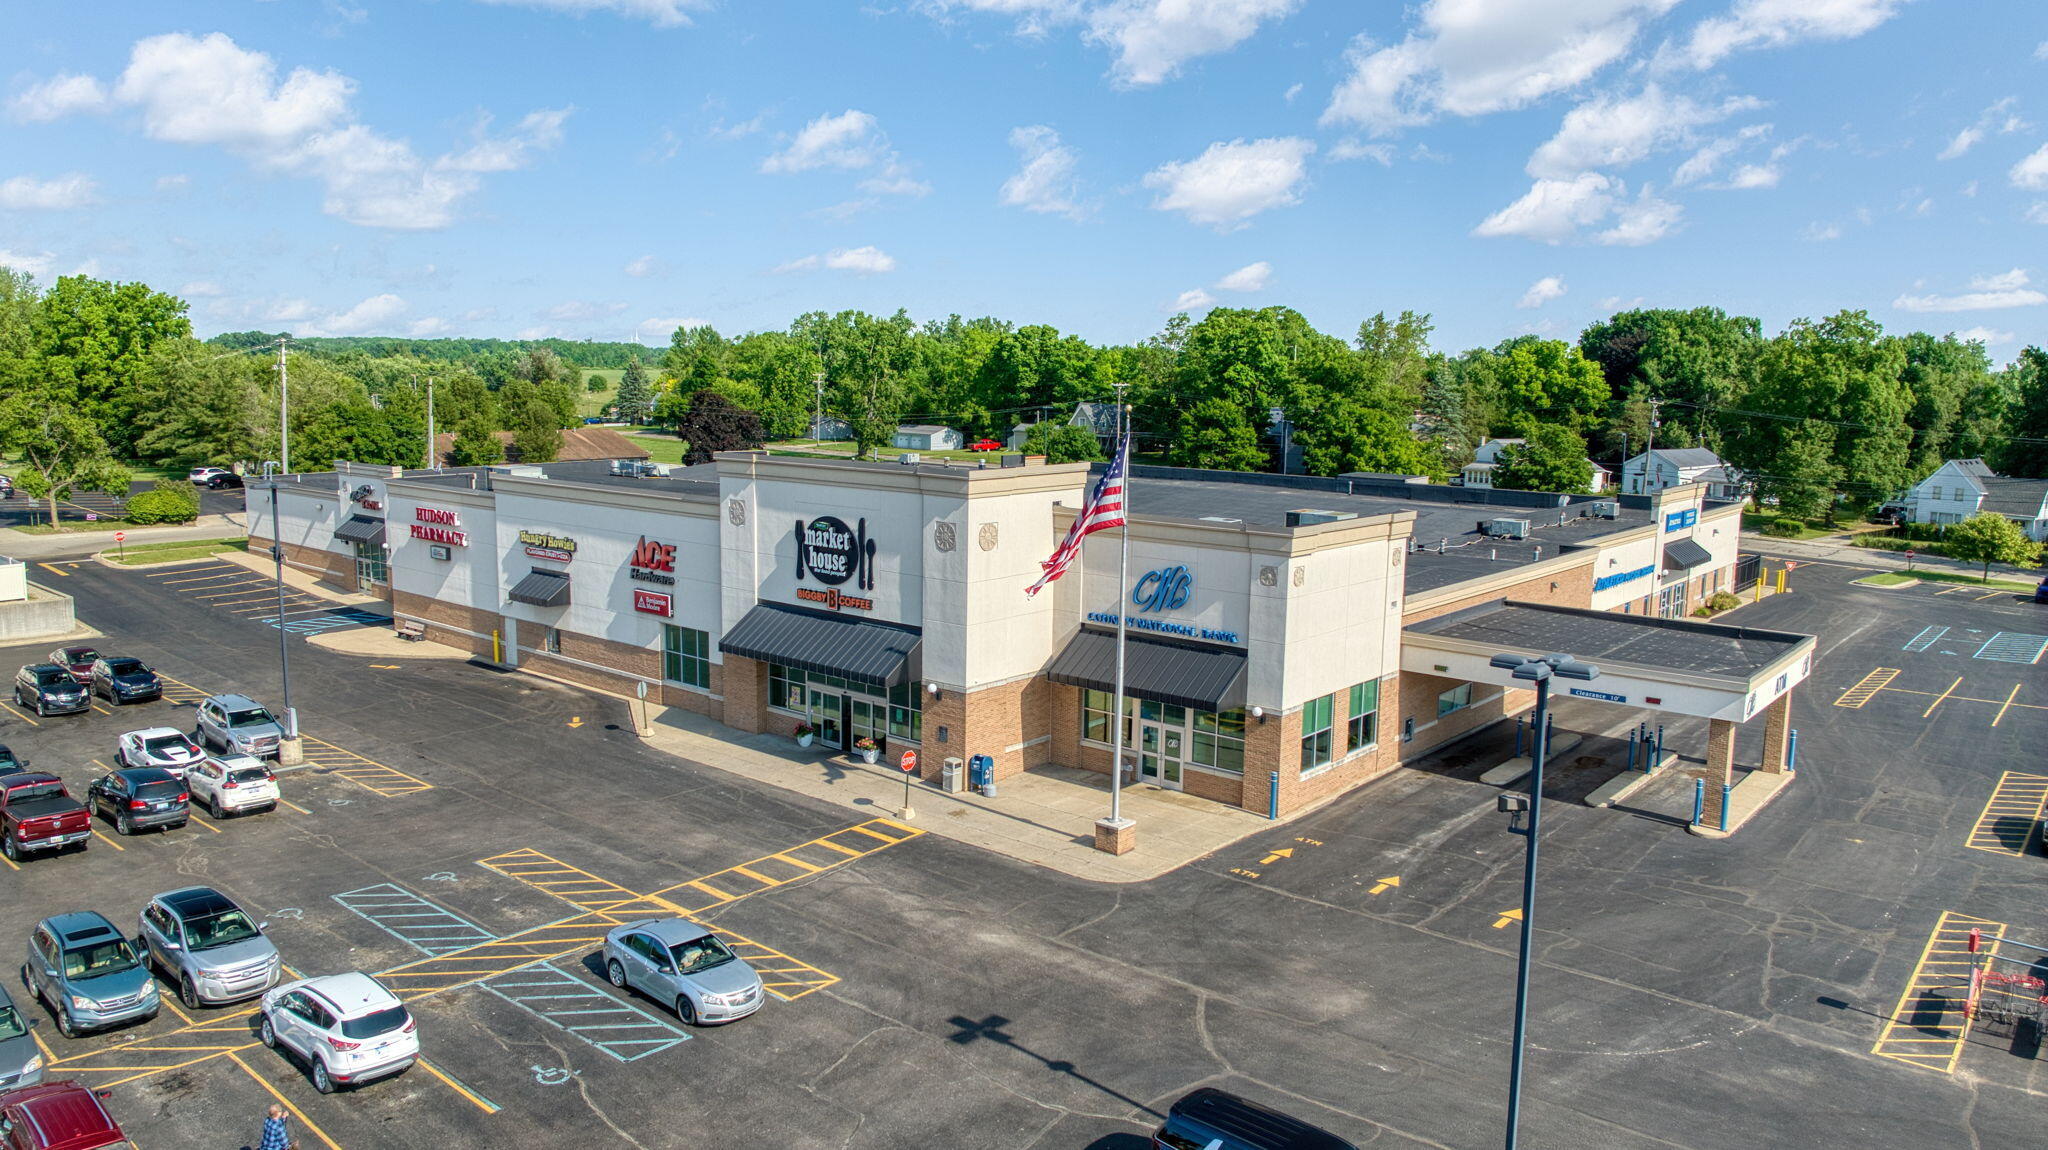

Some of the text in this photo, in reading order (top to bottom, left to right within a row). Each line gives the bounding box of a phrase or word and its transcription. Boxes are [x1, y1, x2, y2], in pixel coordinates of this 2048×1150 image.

[416, 507, 455, 526] HUDSON
[410, 525, 464, 547] PHARMACY
[520, 530, 547, 548] Hungry
[804, 527, 850, 551] market
[630, 535, 676, 573] ACE
[808, 546, 847, 572] house
[630, 568, 675, 585] Hardware
[797, 588, 828, 602] BIGGBY
[839, 595, 873, 610] COFFEE
[1088, 611, 1135, 627] COUNY
[1774, 672, 1788, 696] ATM
[1575, 690, 1607, 699] Clearance
[901, 756, 916, 766] STOP
[1295, 837, 1323, 846] ATM
[1229, 868, 1260, 878] ATM
